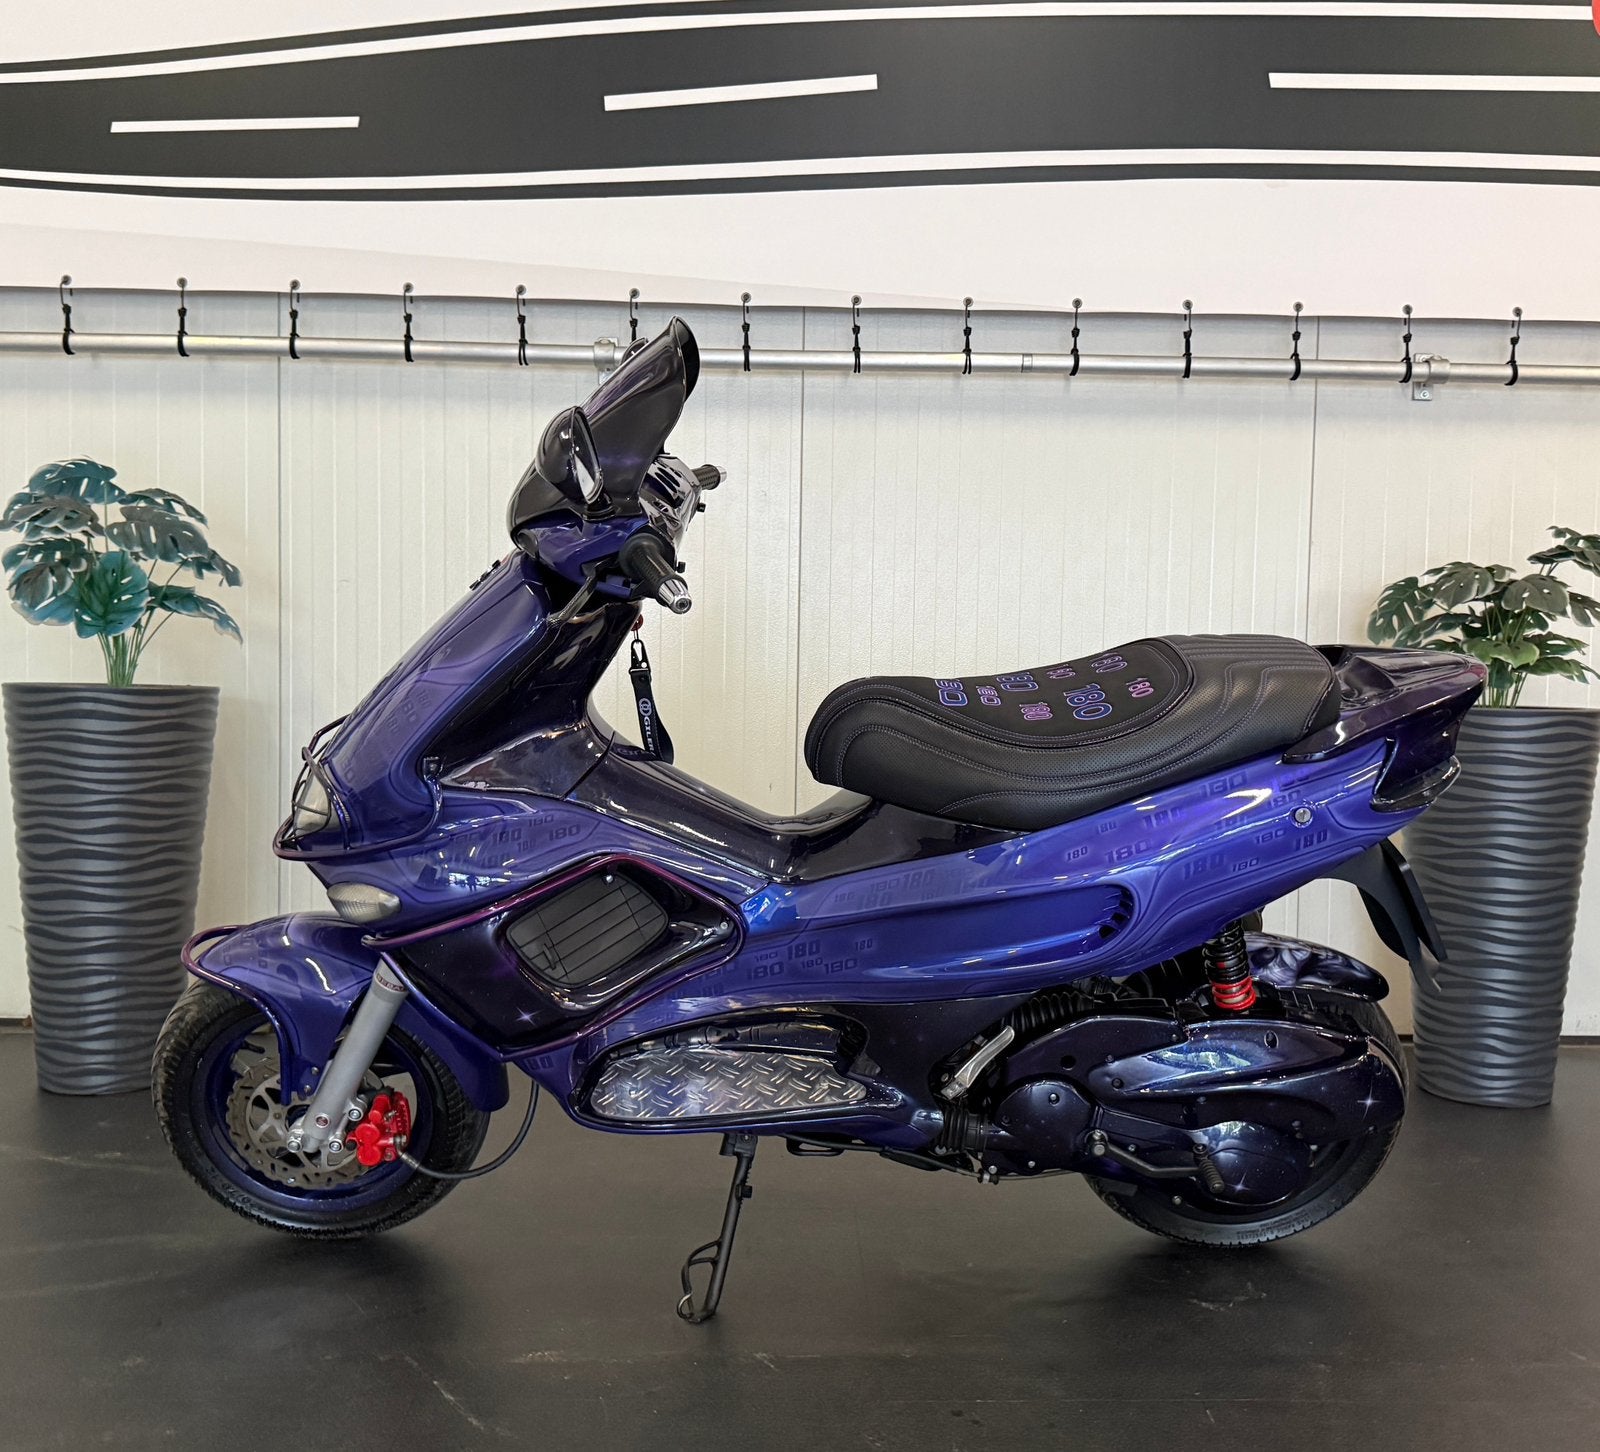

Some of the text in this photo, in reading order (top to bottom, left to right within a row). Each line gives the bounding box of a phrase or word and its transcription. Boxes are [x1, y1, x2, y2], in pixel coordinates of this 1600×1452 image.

[1126, 677, 1154, 698] 180
[1063, 683, 1113, 720] 180
[644, 716, 655, 752] GILER
[1255, 828, 1287, 845] 180
[1295, 828, 1328, 851] 180
[1066, 846, 1088, 862] 180
[1105, 839, 1152, 864] 180
[1232, 858, 1260, 872] 180
[903, 869, 935, 890] 180
[787, 939, 821, 960] 180
[855, 938, 873, 951] 180
[755, 951, 778, 963] 180
[801, 957, 824, 970] 180
[824, 958, 858, 976] 180
[747, 961, 785, 981] 180
